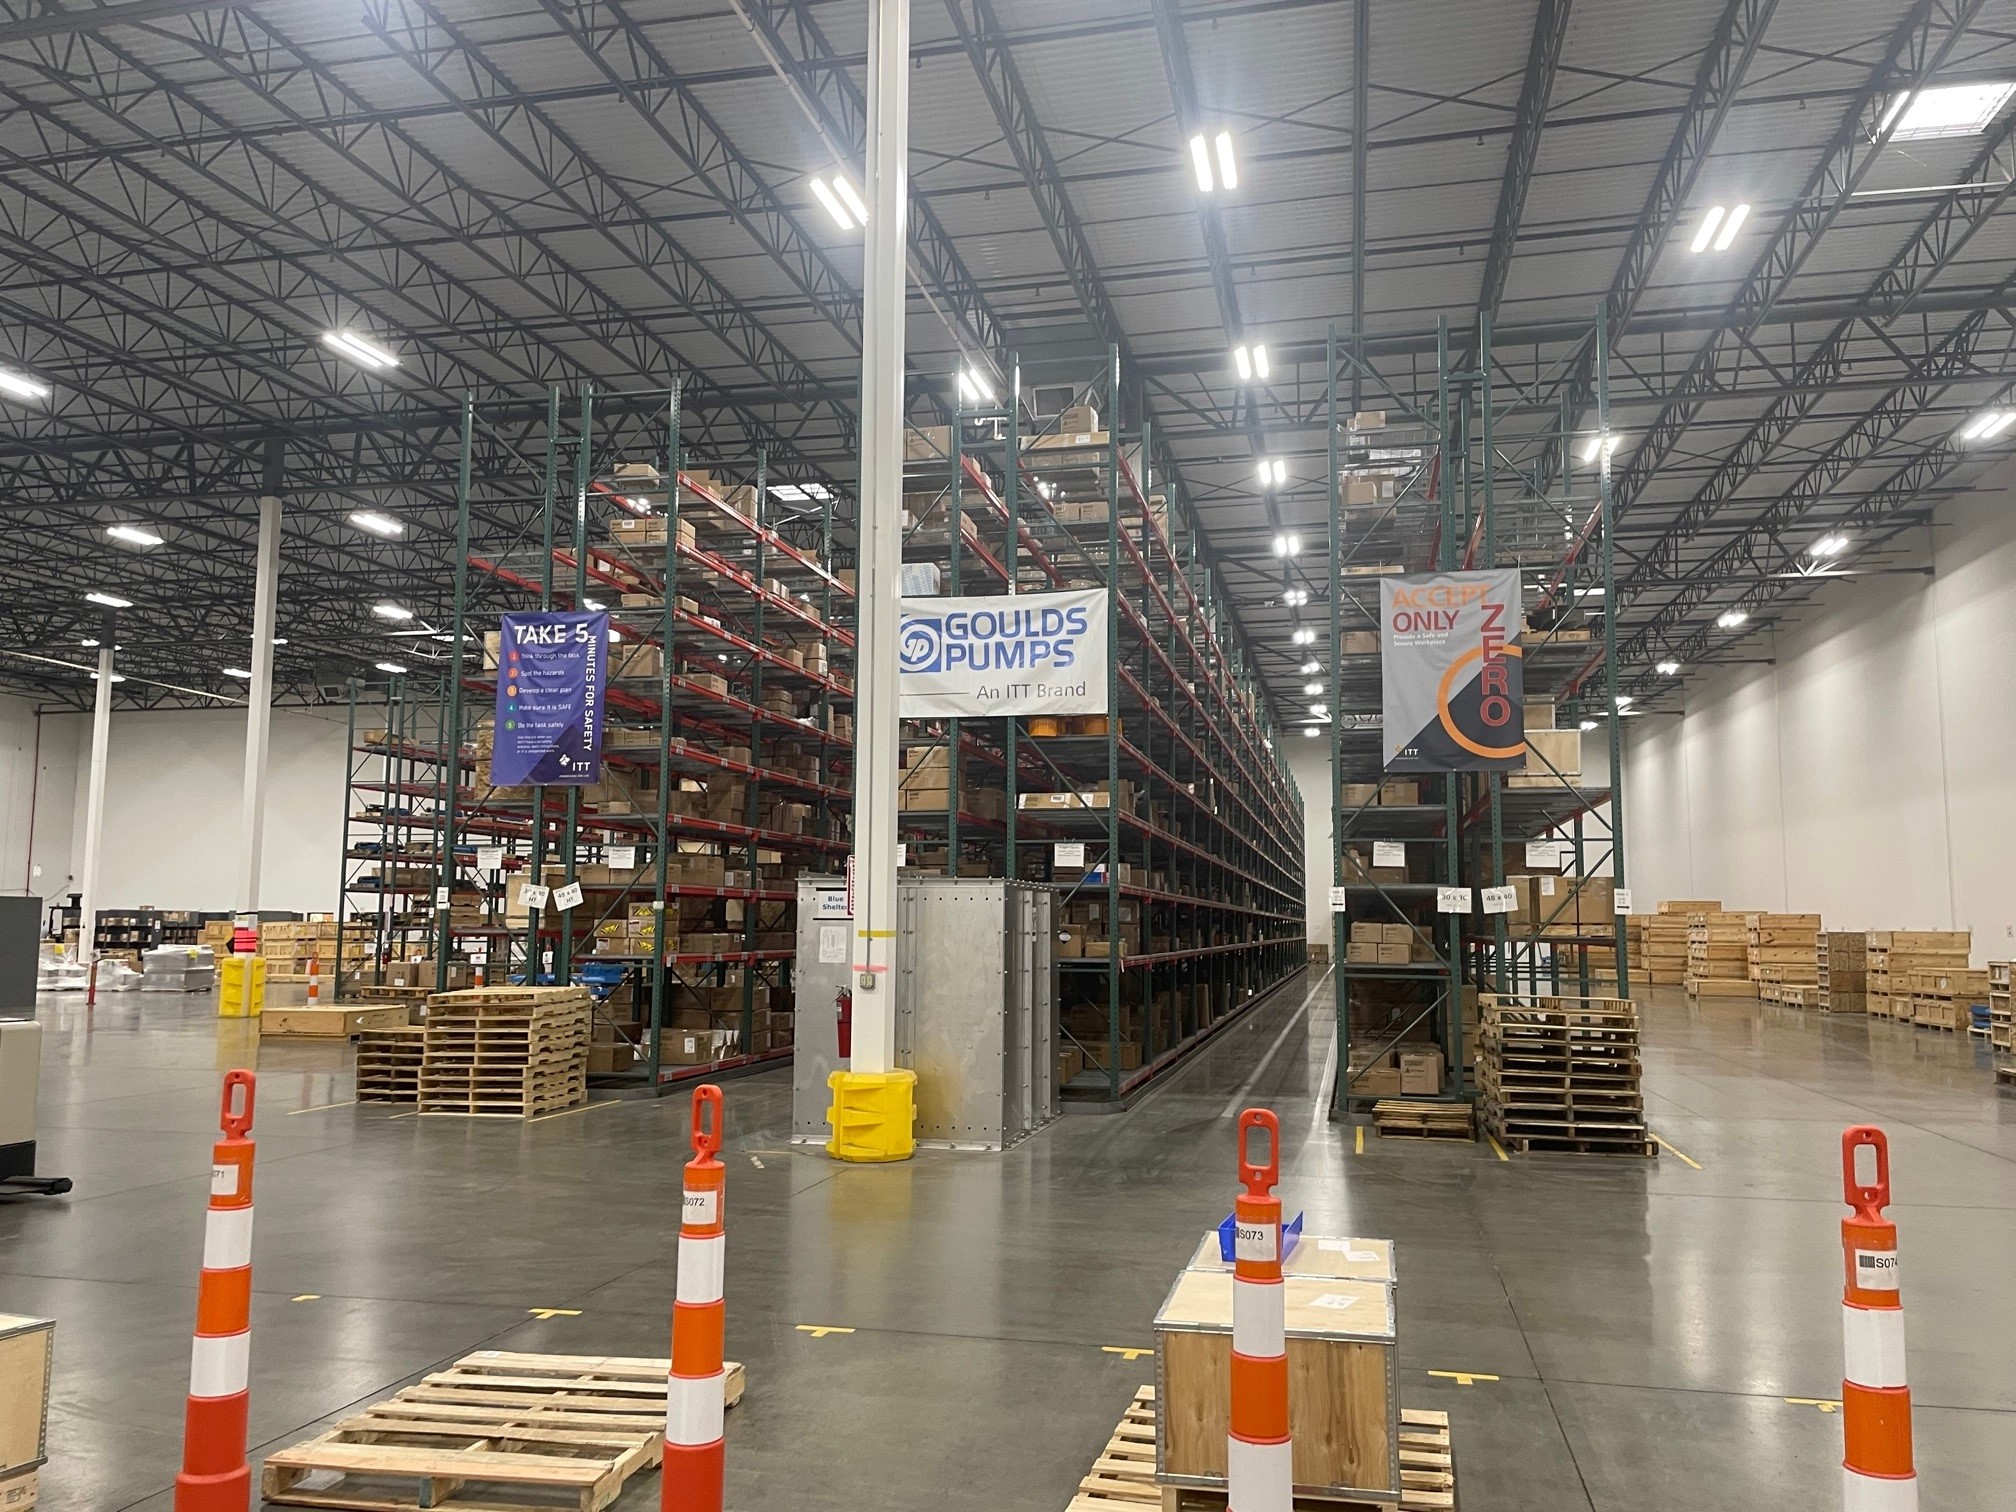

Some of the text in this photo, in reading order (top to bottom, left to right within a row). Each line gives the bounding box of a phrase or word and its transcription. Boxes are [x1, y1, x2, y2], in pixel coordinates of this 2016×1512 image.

[1392, 583, 1493, 609] ACCEPT
[945, 606, 1088, 640] GOULDS
[1392, 609, 1460, 633] ONLY
[513, 623, 589, 644] TAKE 5
[945, 639, 1075, 672] PUMPS
[1479, 603, 1511, 727] ZERO
[583, 635, 597, 751] MINUTES FOR SAFETY
[976, 681, 1087, 700] An ITT Brand
[1404, 748, 1419, 756] ITT
[572, 762, 591, 772] ITT
[1239, 1229, 1264, 1241] S073
